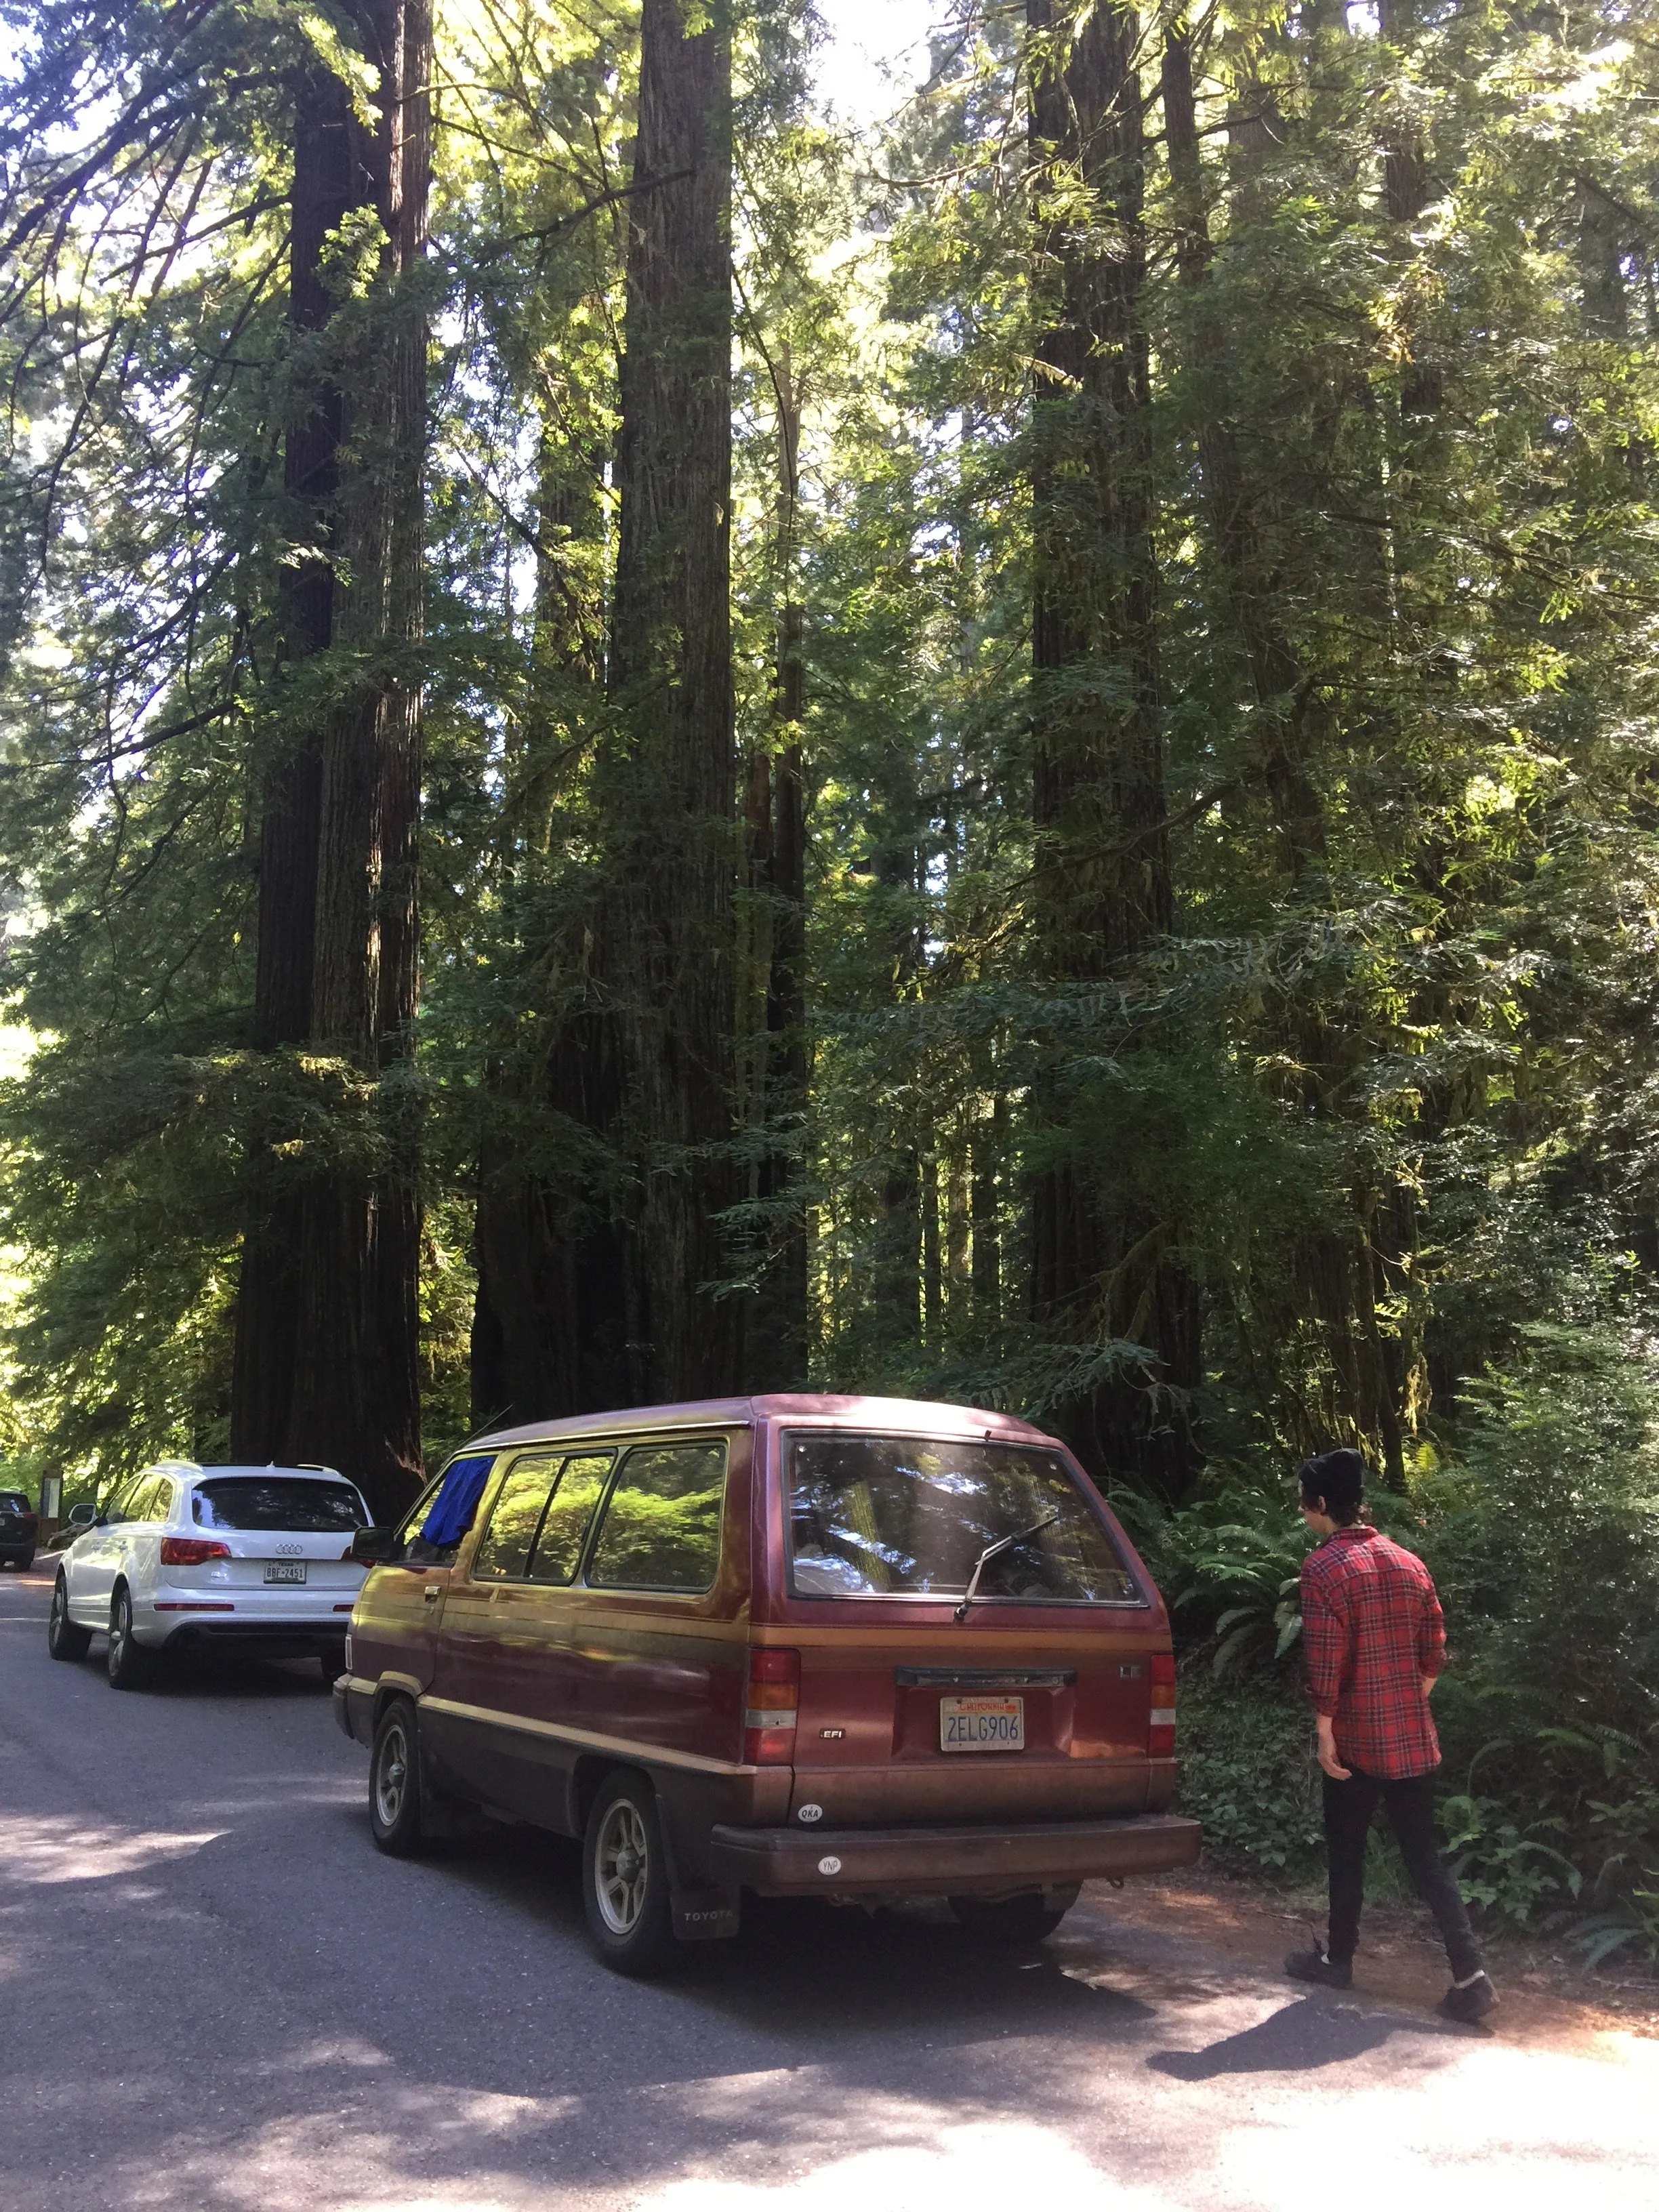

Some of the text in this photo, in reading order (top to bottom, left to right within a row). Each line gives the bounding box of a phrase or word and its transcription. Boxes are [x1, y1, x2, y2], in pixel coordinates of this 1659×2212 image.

[948, 1715, 1019, 1742] 2ELG906
[823, 1860, 838, 1871] YNP
[684, 1910, 734, 1921] TOYOTA
